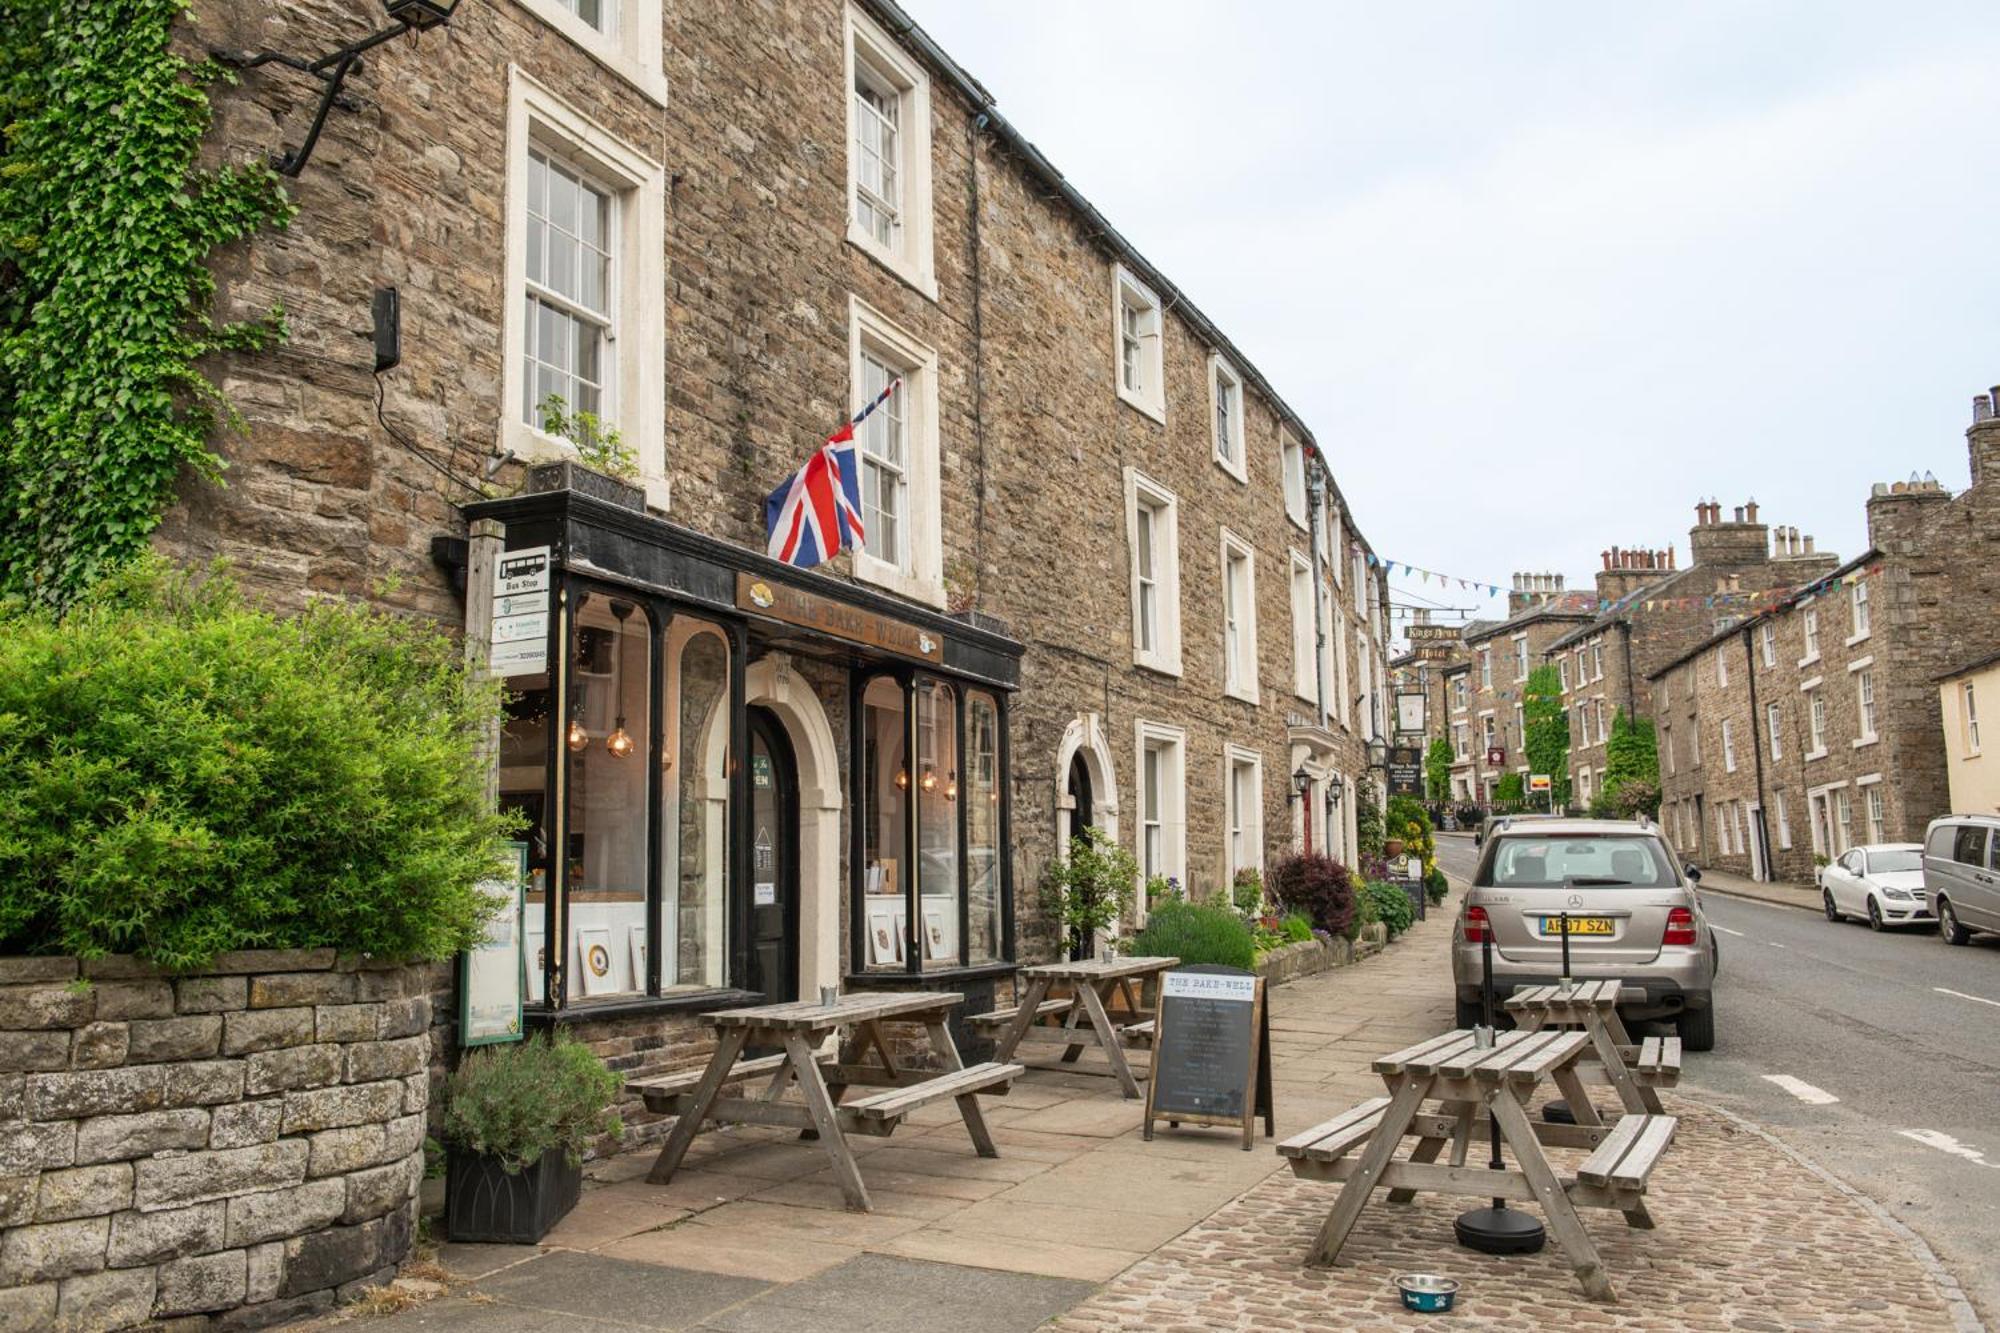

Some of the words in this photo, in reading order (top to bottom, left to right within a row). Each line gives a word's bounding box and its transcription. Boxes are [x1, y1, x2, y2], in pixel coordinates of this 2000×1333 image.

[506, 582, 519, 591] Bus
[522, 579, 539, 588] Stop
[1408, 628, 1433, 639] Kings
[1434, 628, 1457, 638] Arms
[1587, 919, 1613, 932] SZN
[1168, 977, 1189, 987] THE
